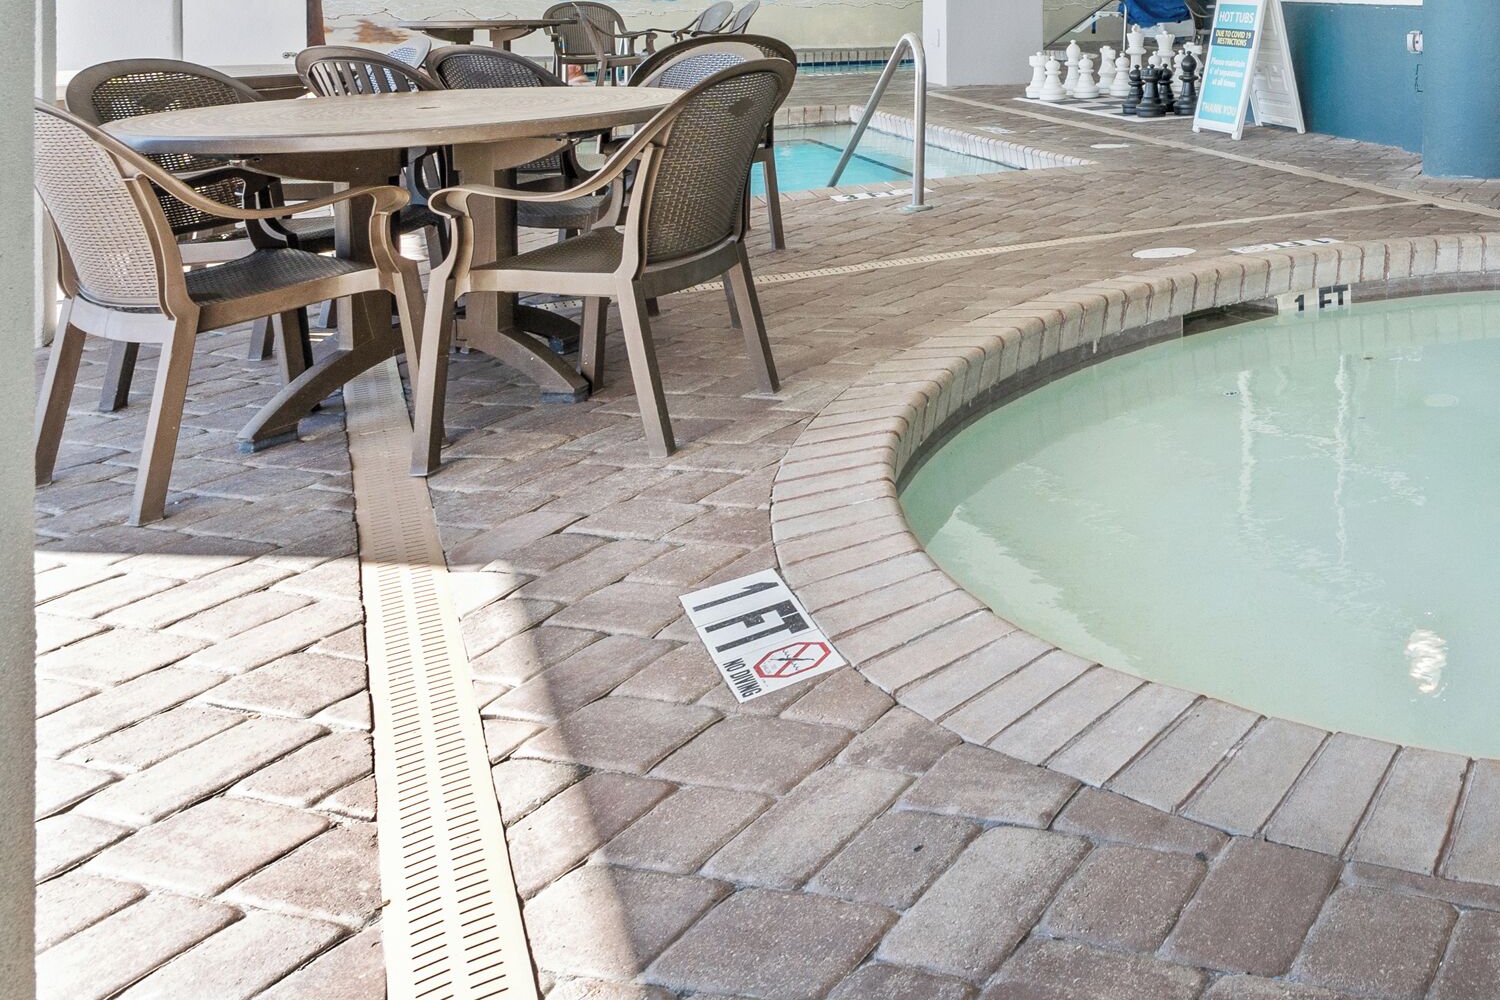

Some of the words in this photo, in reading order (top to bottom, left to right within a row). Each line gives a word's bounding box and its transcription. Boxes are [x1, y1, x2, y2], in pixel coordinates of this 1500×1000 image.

[1219, 11, 1234, 22] HOT
[1236, 12, 1254, 23] TUBS
[1294, 294, 1305, 311] 1
[1318, 284, 1349, 308] FT
[692, 581, 780, 612] 1
[704, 599, 810, 653] FT
[723, 657, 746, 672] NO
[730, 669, 762, 698] DIVING
